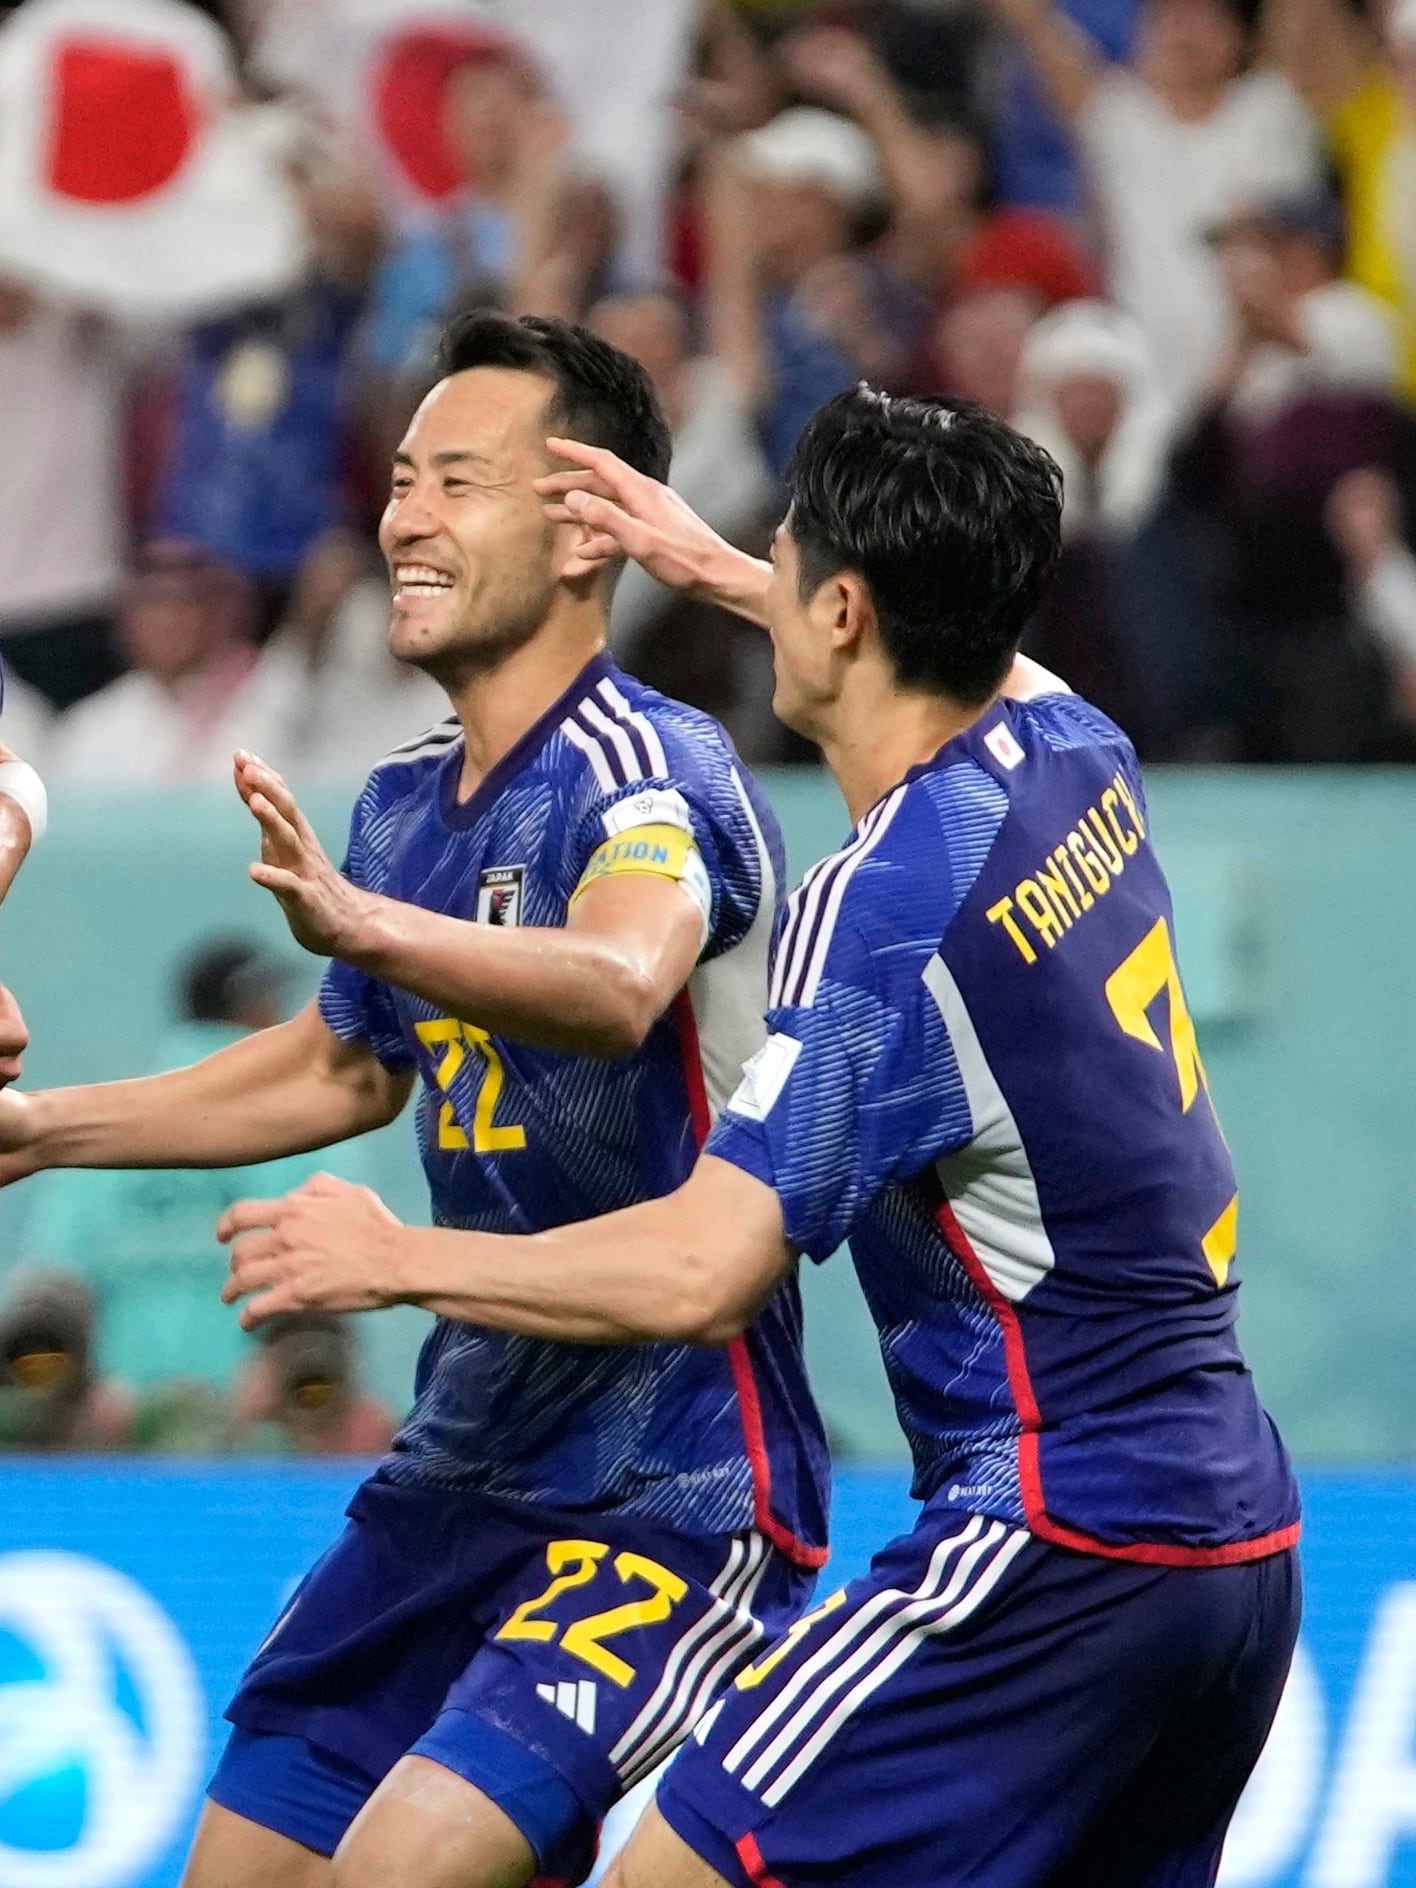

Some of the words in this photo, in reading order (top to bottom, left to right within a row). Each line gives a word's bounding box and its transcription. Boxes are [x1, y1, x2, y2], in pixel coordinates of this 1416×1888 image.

[486, 871, 514, 883] JAPAN
[414, 1018, 527, 1153] 22
[494, 1540, 689, 1688] 22
